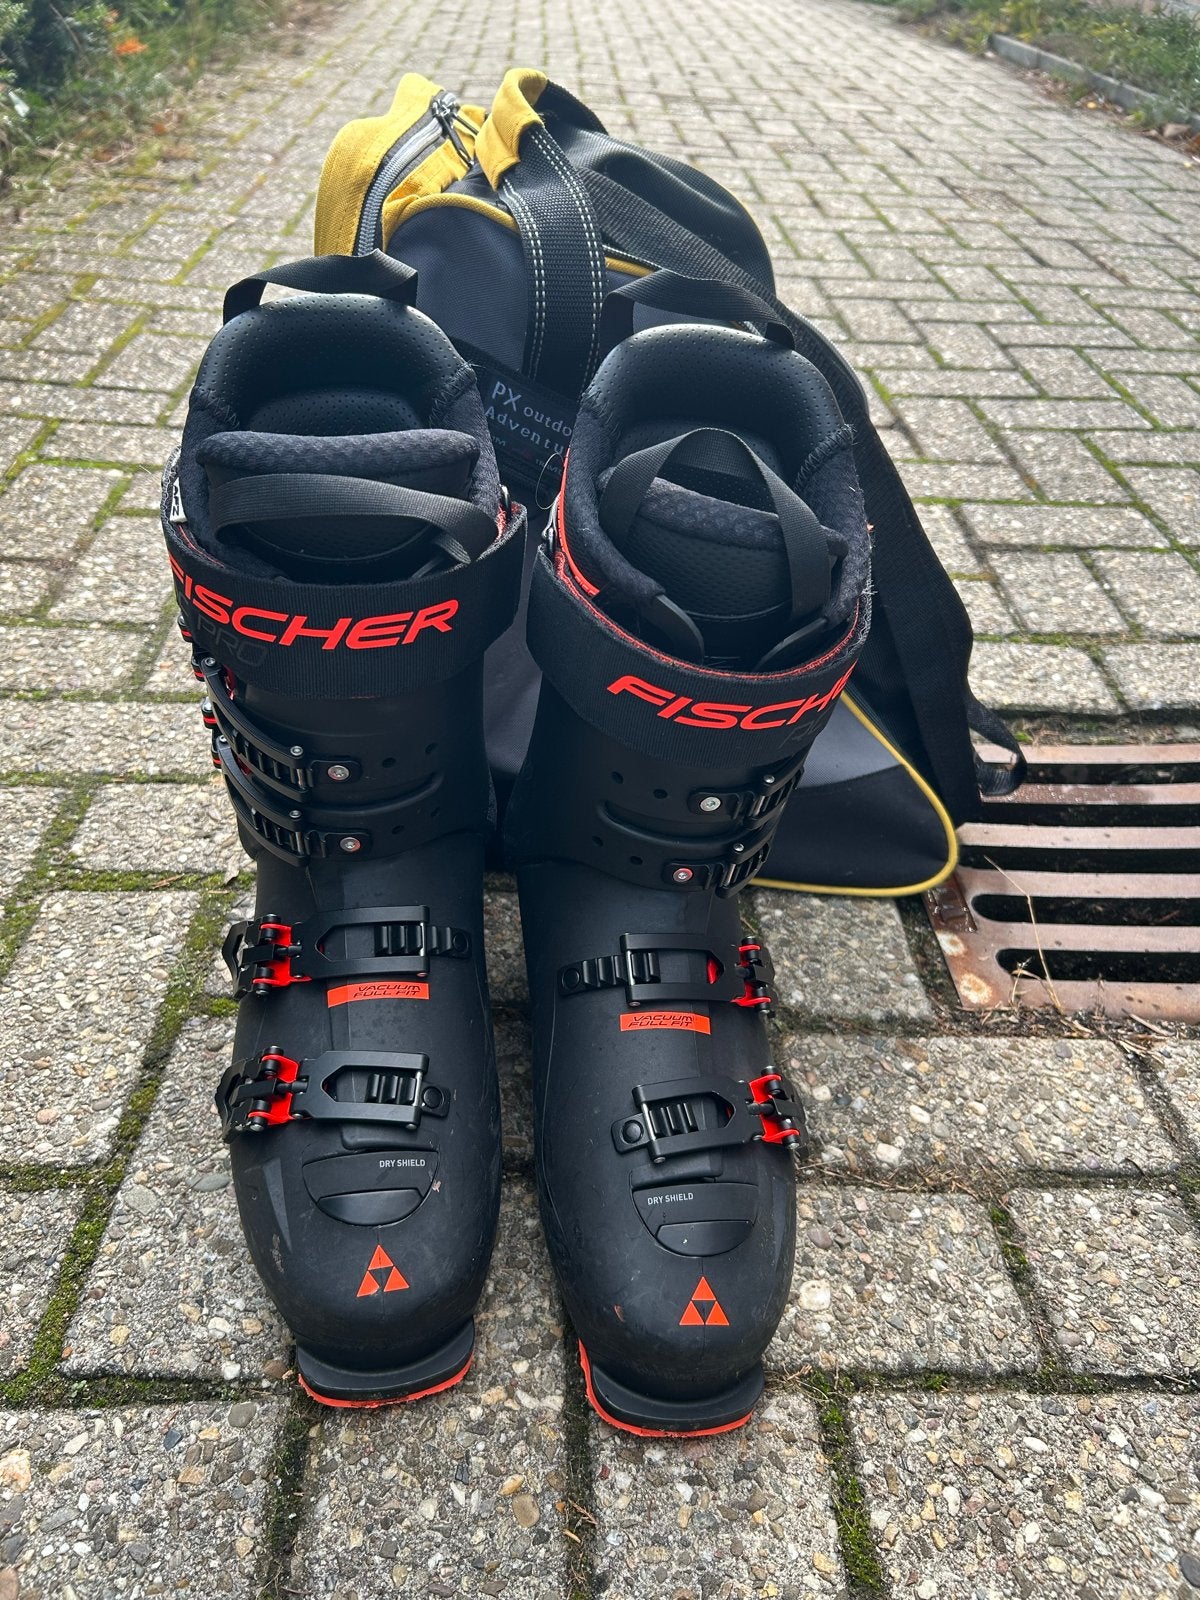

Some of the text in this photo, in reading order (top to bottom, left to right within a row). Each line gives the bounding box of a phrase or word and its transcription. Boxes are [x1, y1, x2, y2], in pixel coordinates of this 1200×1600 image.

[358, 984, 421, 992] VACUUM
[353, 990, 391, 998] FULL
[633, 1014, 694, 1022] VACUUM
[628, 1020, 668, 1028] FULL
[379, 1159, 426, 1168] DRY SHIELD
[647, 1192, 694, 1206] DRY SHIELD
